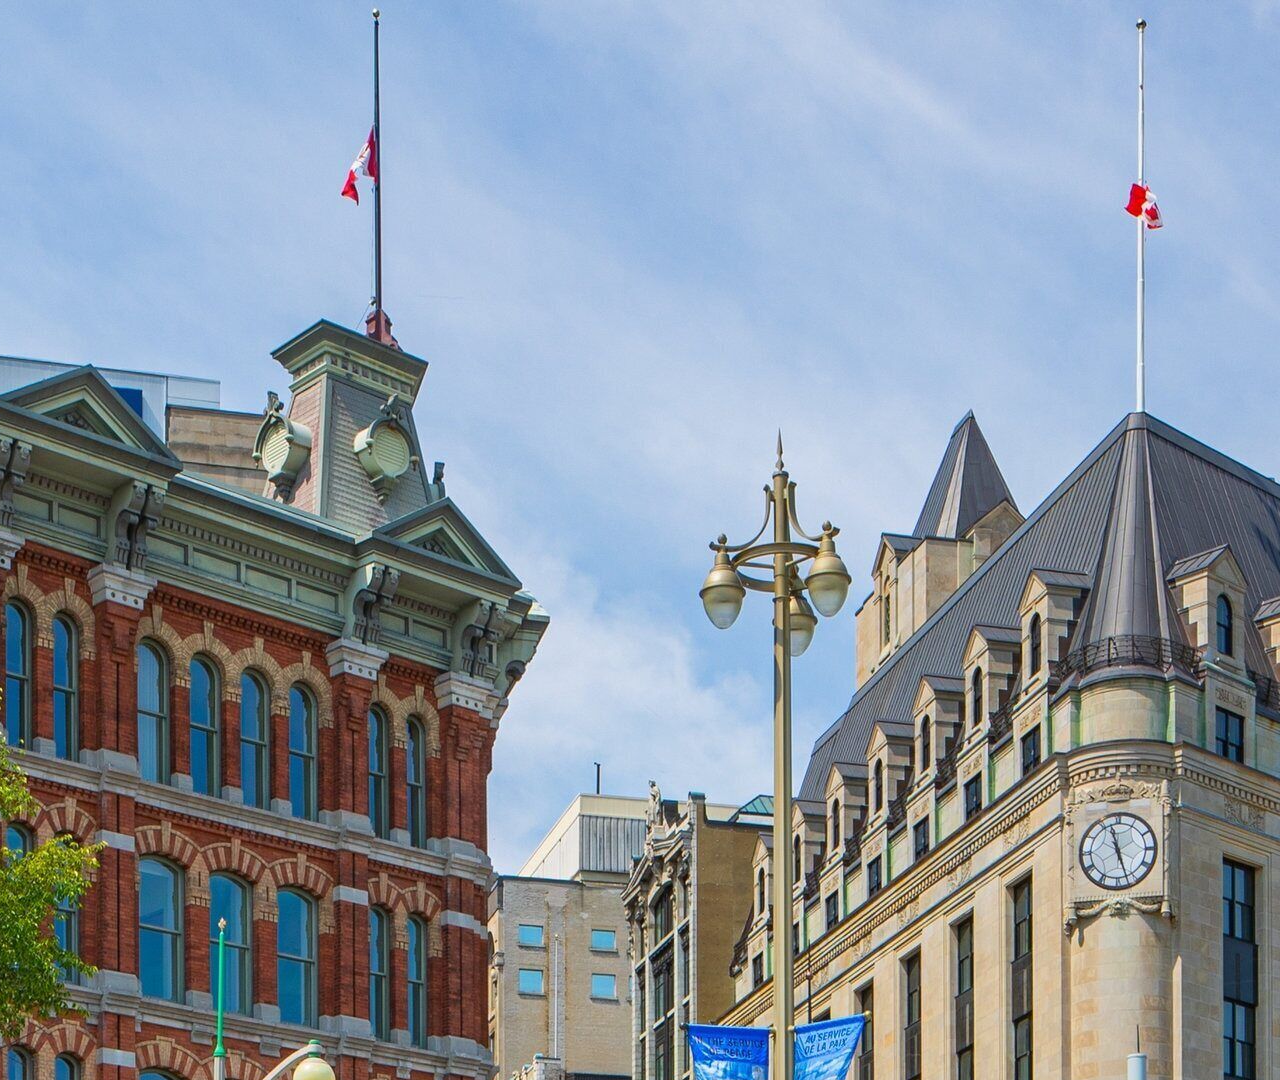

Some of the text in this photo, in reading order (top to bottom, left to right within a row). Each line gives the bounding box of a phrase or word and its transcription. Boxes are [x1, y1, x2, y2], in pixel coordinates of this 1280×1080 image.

[707, 1037, 724, 1047] THE
[728, 1038, 765, 1049] SERVICE
[805, 1028, 852, 1044] AU SERVICE
[804, 1038, 847, 1054] DE LA PAIX
[725, 1048, 753, 1059] PEACE
